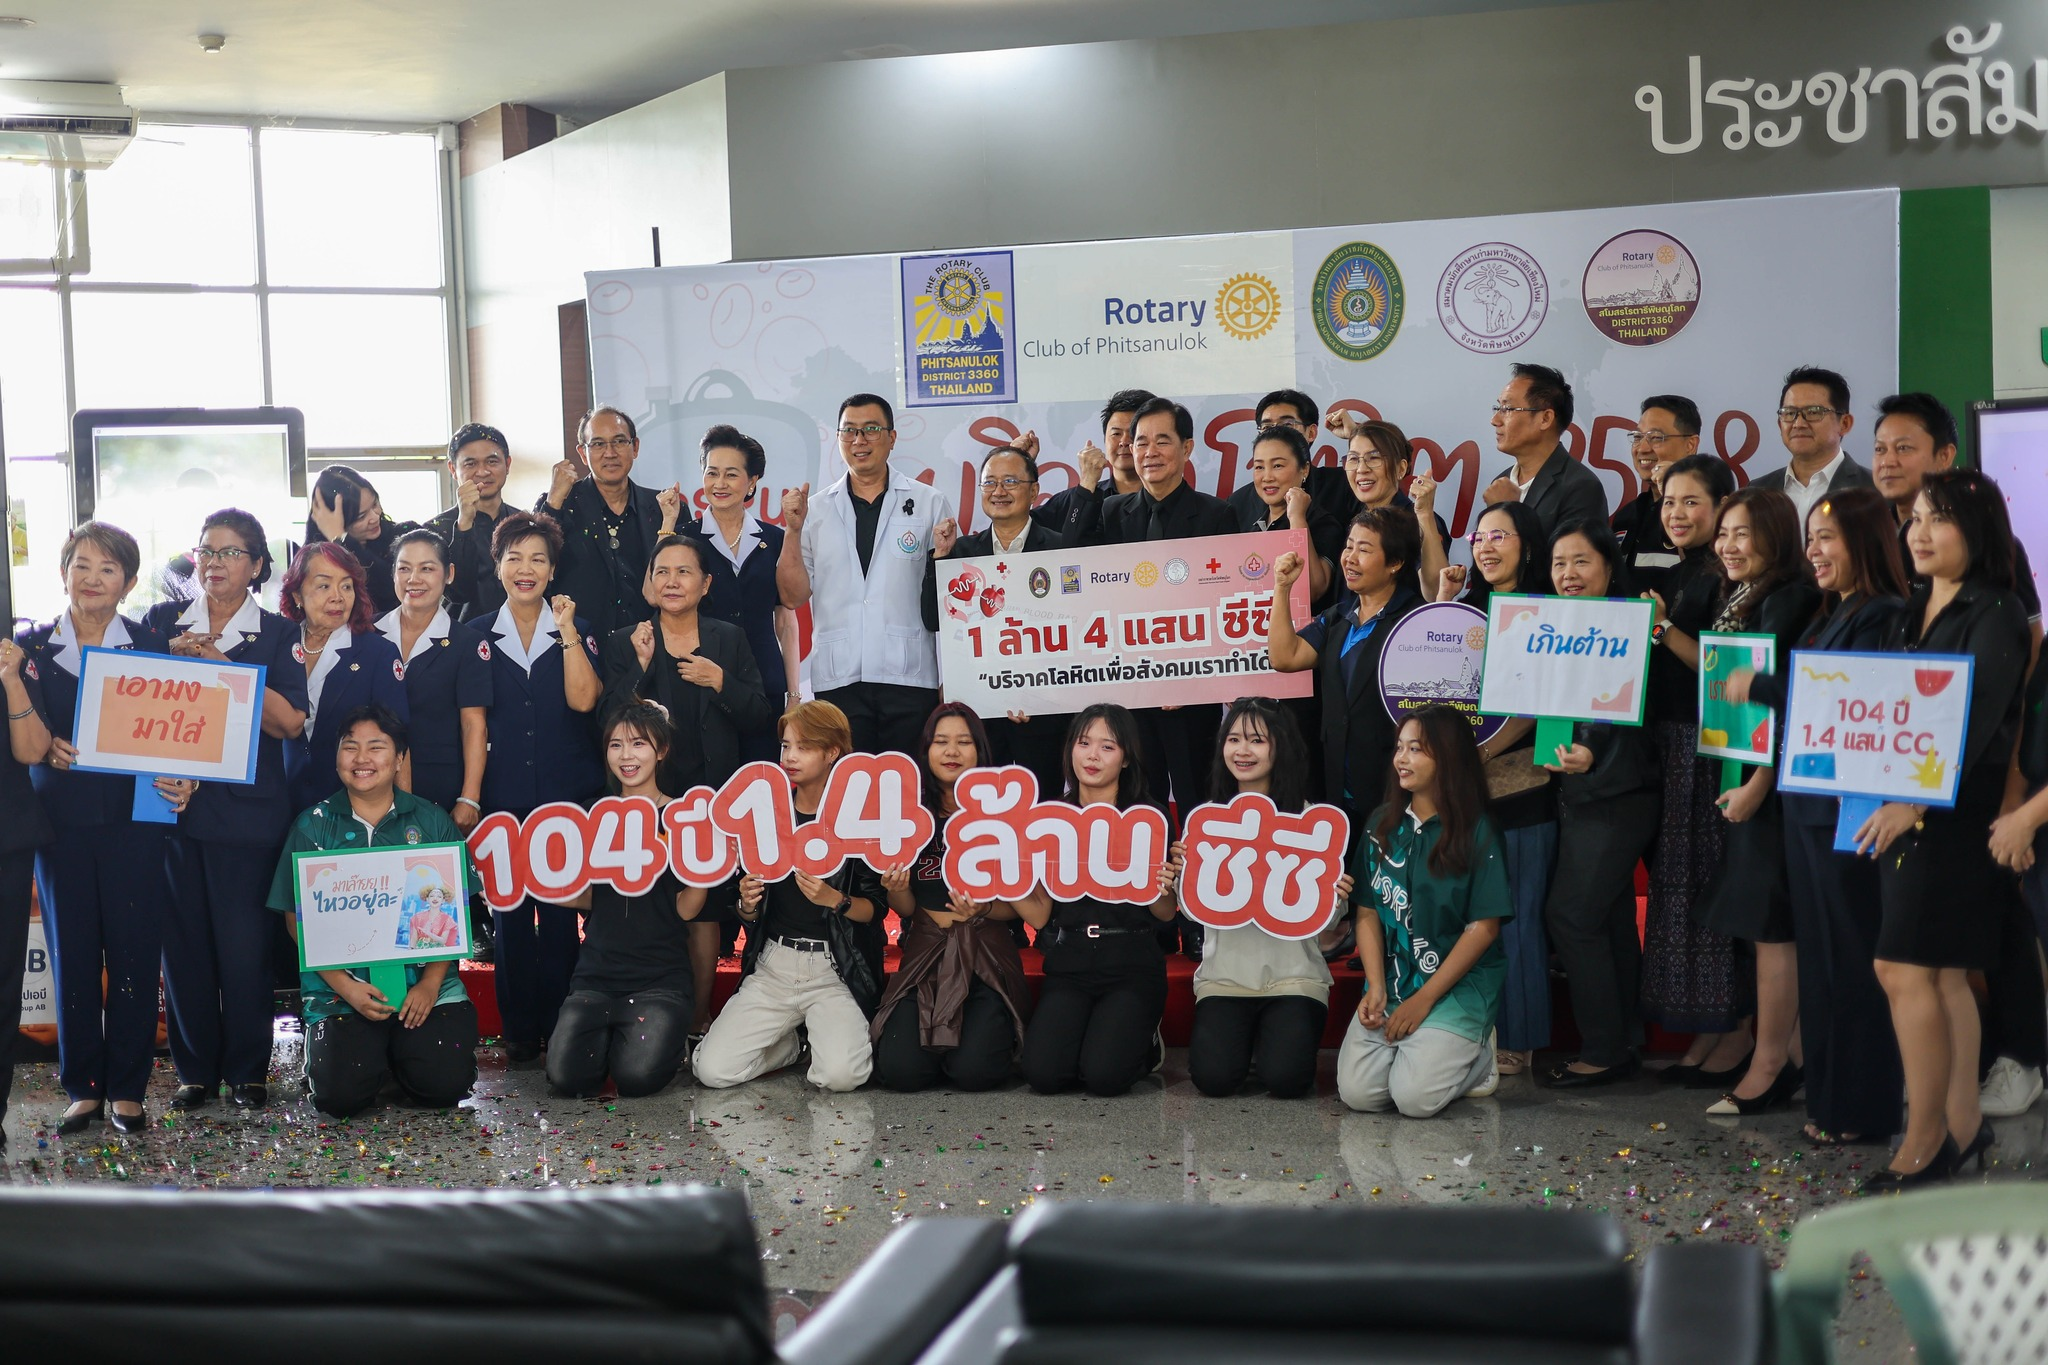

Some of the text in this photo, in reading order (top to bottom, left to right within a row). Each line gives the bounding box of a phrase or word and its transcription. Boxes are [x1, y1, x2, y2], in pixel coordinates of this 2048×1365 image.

[1620, 262, 1654, 270] Phitsanulok
[1622, 252, 1654, 261] Rotary
[925, 259, 990, 294] THE ROTARY CLUB
[1104, 297, 1207, 327] Rotary
[1023, 332, 1208, 358] Club of Phitsanulok
[1461, 331, 1526, 349] จังหวัดพิษณุโลก
[1618, 327, 1668, 338] THAILAND
[921, 355, 999, 369] PHITSANULOK
[922, 369, 999, 382] DISTRICT 3360
[929, 383, 993, 396] THAILAND
[1091, 572, 1130, 583] Rotary
[968, 626, 983, 657] 1
[999, 617, 1068, 656] ล้าน
[1083, 617, 1109, 648] 4
[1124, 613, 1206, 646] แสน
[1427, 631, 1463, 644] Rotary
[1526, 624, 1629, 658] เกินต้าน
[1398, 644, 1414, 652] Club
[1424, 645, 1463, 653] Phitsanulok
[116, 674, 202, 703] เอามง
[1838, 698, 1910, 726] 104 ปี
[132, 709, 206, 744] มาใส่
[1803, 724, 1836, 749] 1.4
[1843, 732, 1885, 753] แสน
[475, 808, 654, 898] 104
[728, 769, 916, 867] 1.4
[958, 781, 1152, 890] ล้าน
[312, 888, 398, 916] ไหวอยู่ละ
